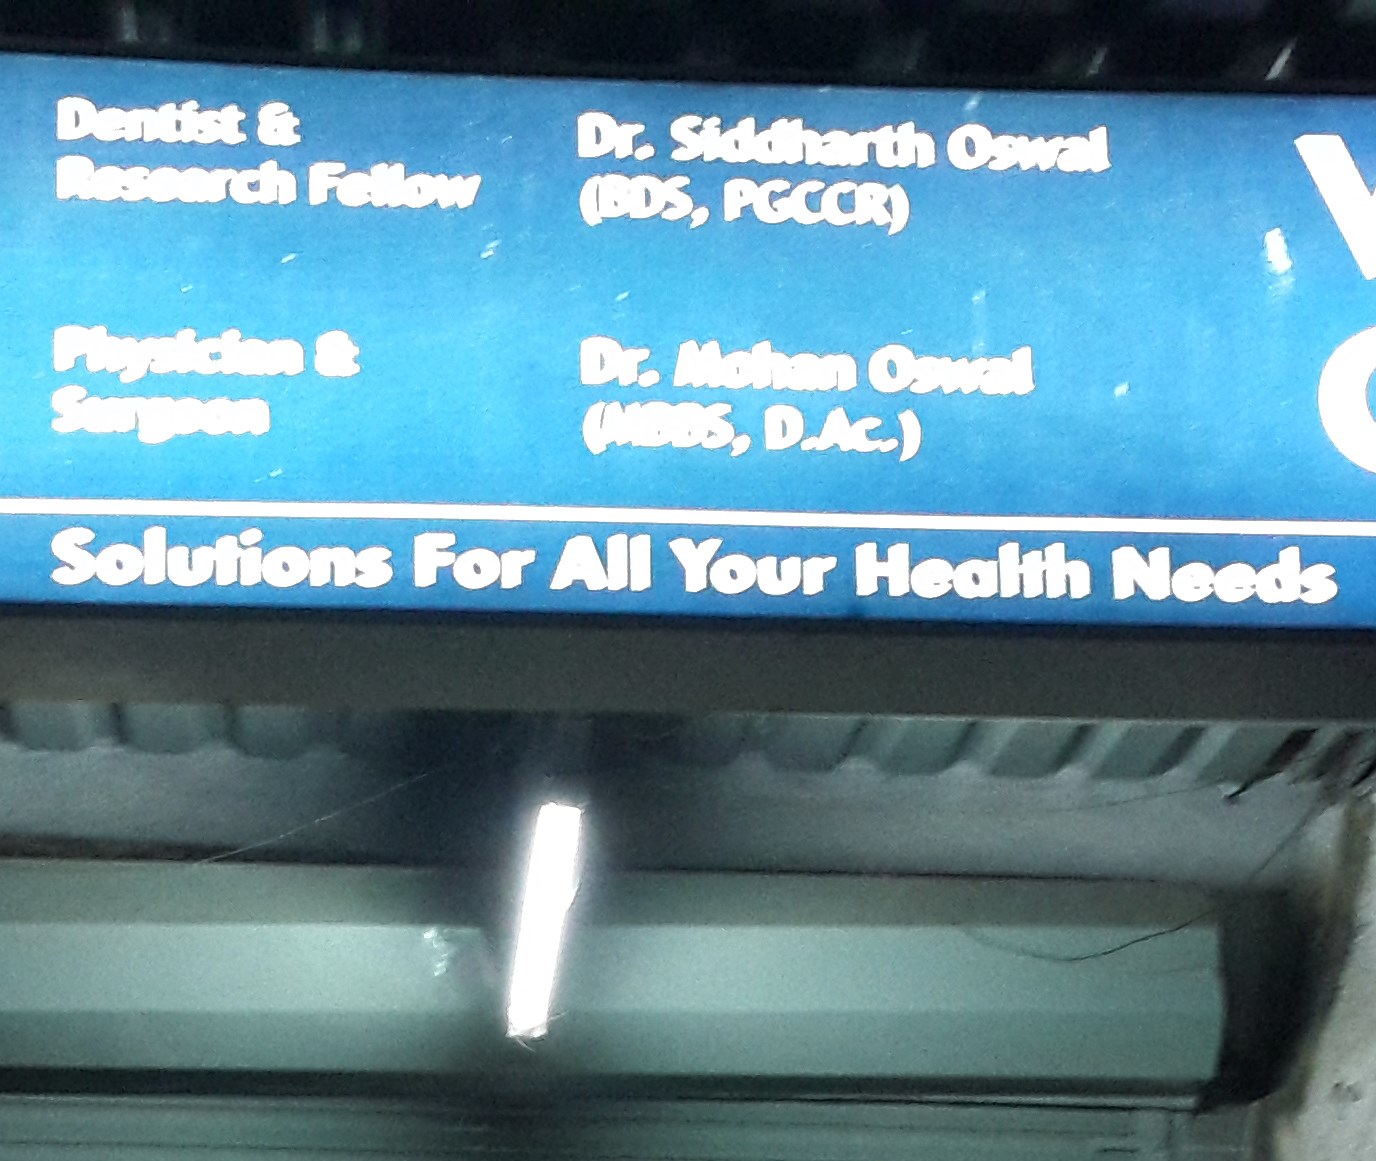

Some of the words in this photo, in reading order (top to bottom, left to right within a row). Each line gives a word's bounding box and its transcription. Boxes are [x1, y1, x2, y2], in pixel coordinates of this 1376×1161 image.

[55, 95, 247, 146] Dentist
[256, 101, 302, 148] &
[577, 110, 655, 161] Dr.
[670, 114, 936, 169] Siddharth
[946, 122, 1112, 173] Oswal
[54, 154, 297, 206] Research
[308, 160, 483, 210] Fellow
[578, 173, 711, 230] (BDS,
[52, 323, 306, 384] Physician
[314, 329, 362, 378] &
[578, 334, 660, 389] Dr.
[672, 338, 858, 392] Mohan
[867, 343, 1037, 397] Oswal
[51, 384, 271, 445] Surgeon
[581, 400, 751, 458] (MBBS,
[50, 525, 395, 590] Solutions
[412, 531, 537, 591] For
[548, 532, 652, 593] All
[668, 536, 838, 597] Your
[854, 541, 1092, 600] Health
[1111, 545, 1339, 605] Needs
